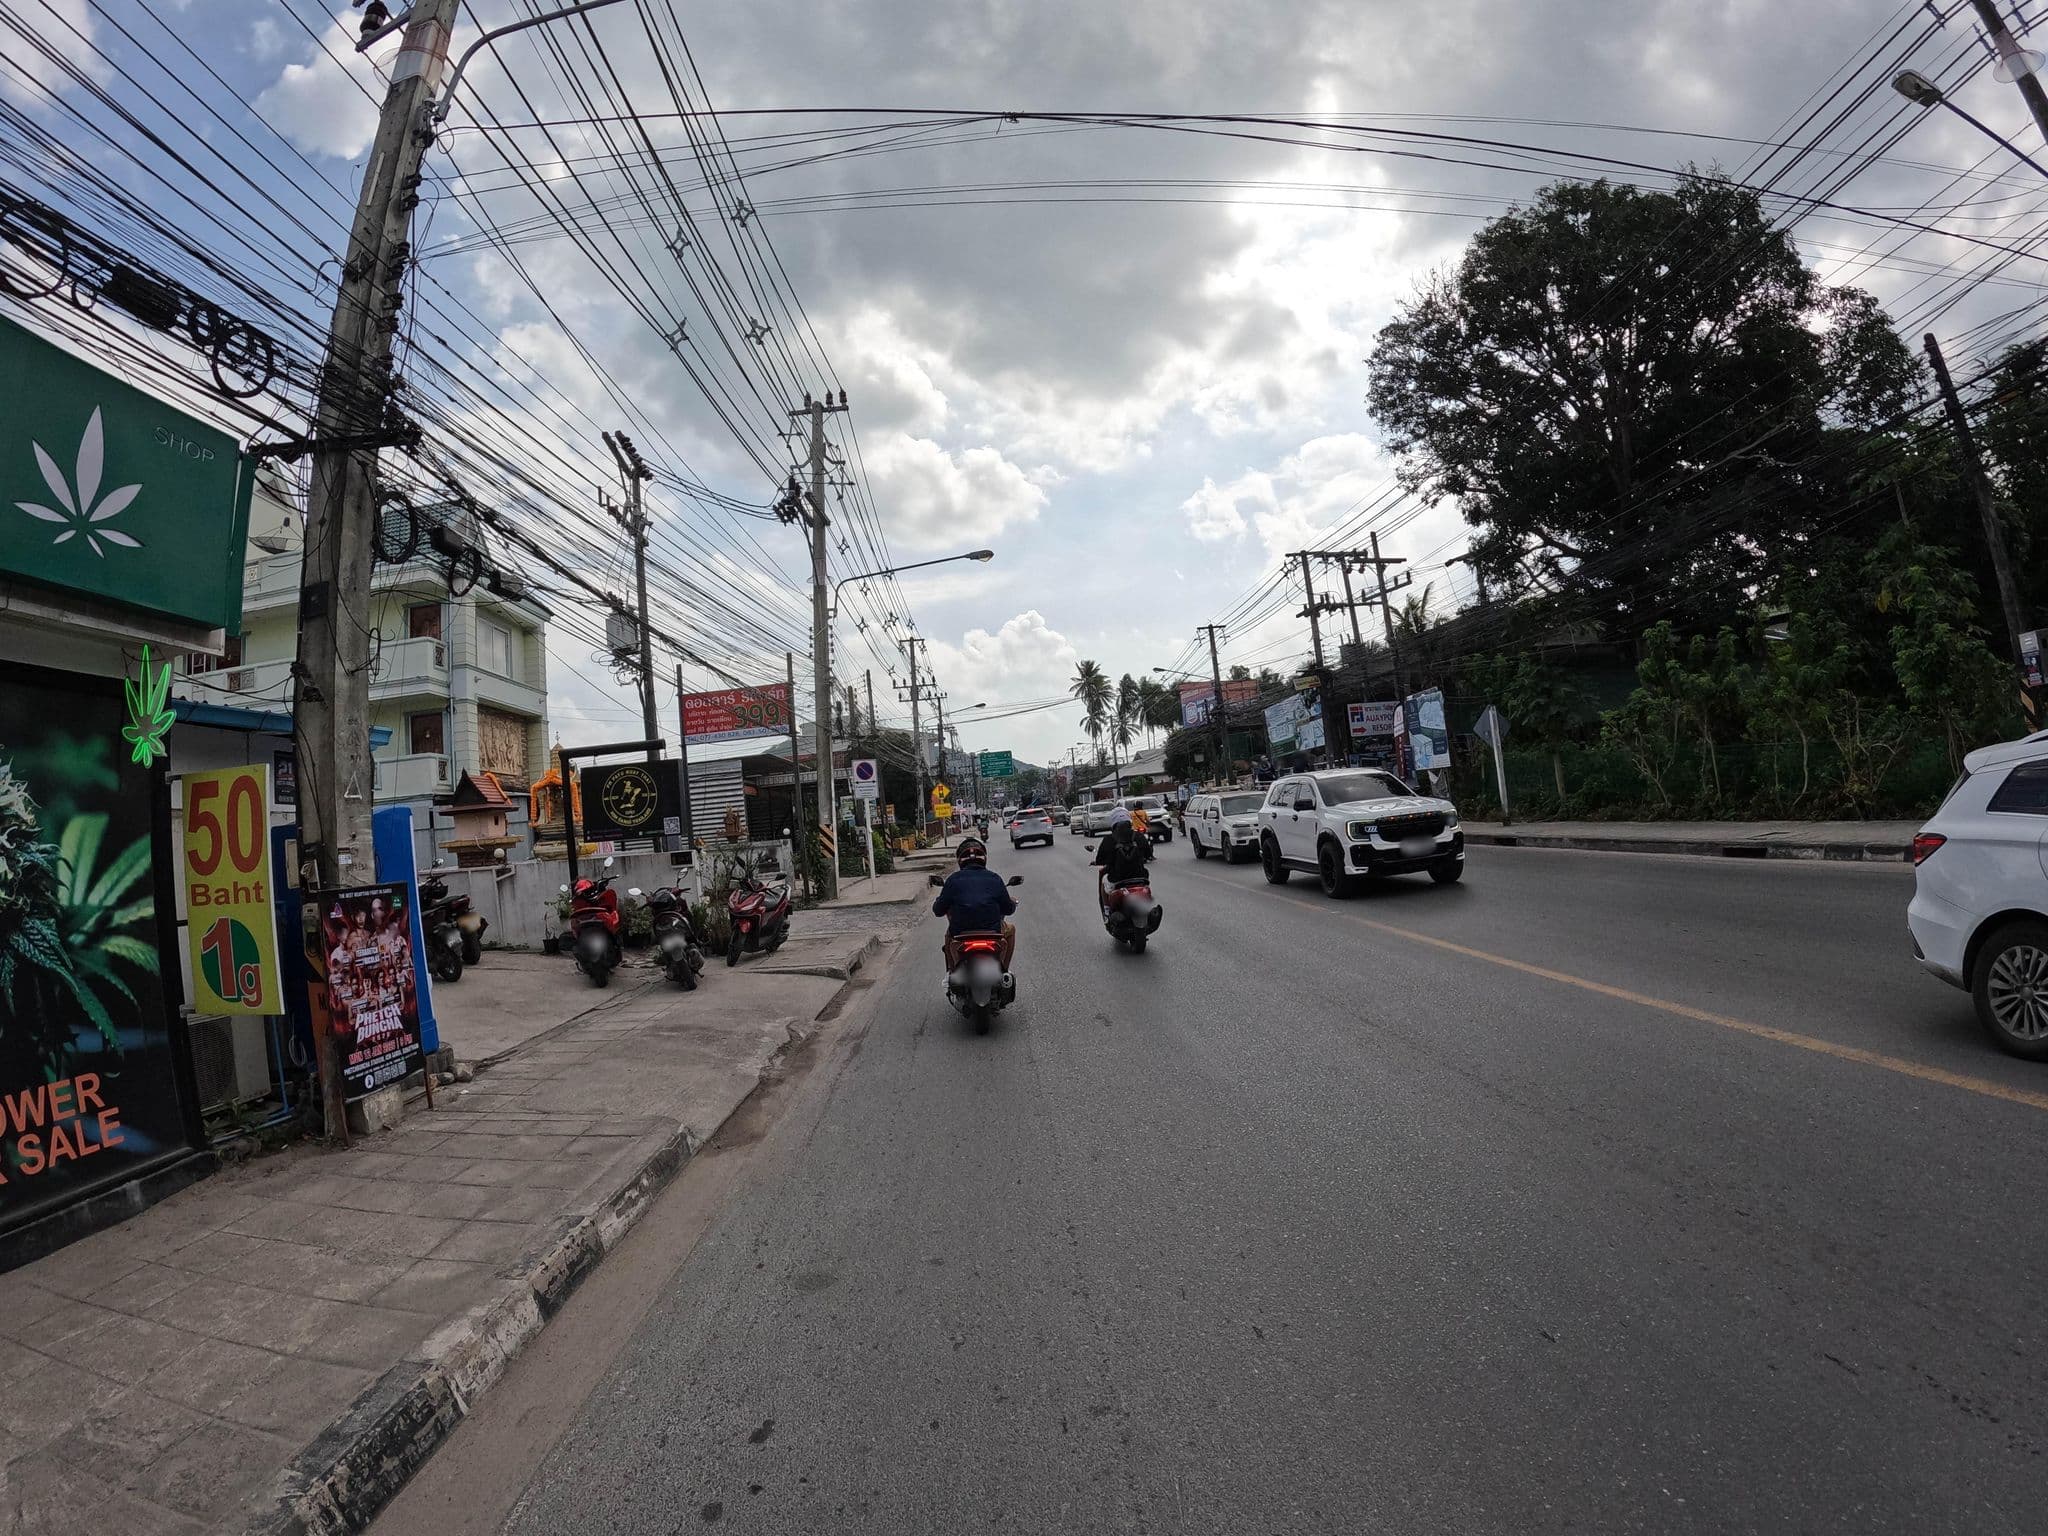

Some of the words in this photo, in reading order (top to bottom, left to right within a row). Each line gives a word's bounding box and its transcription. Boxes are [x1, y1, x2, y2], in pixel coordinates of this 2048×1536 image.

[153, 426, 216, 464] SHOP
[734, 702, 780, 729] 399
[1372, 723, 1393, 733] RESOR
[187, 775, 264, 877] 50
[191, 880, 265, 907] Baht
[201, 916, 263, 1008] 1g
[355, 1002, 402, 1030] PHETCH
[356, 1016, 404, 1044] BUNCHA
[17, 1107, 125, 1175] SALE
